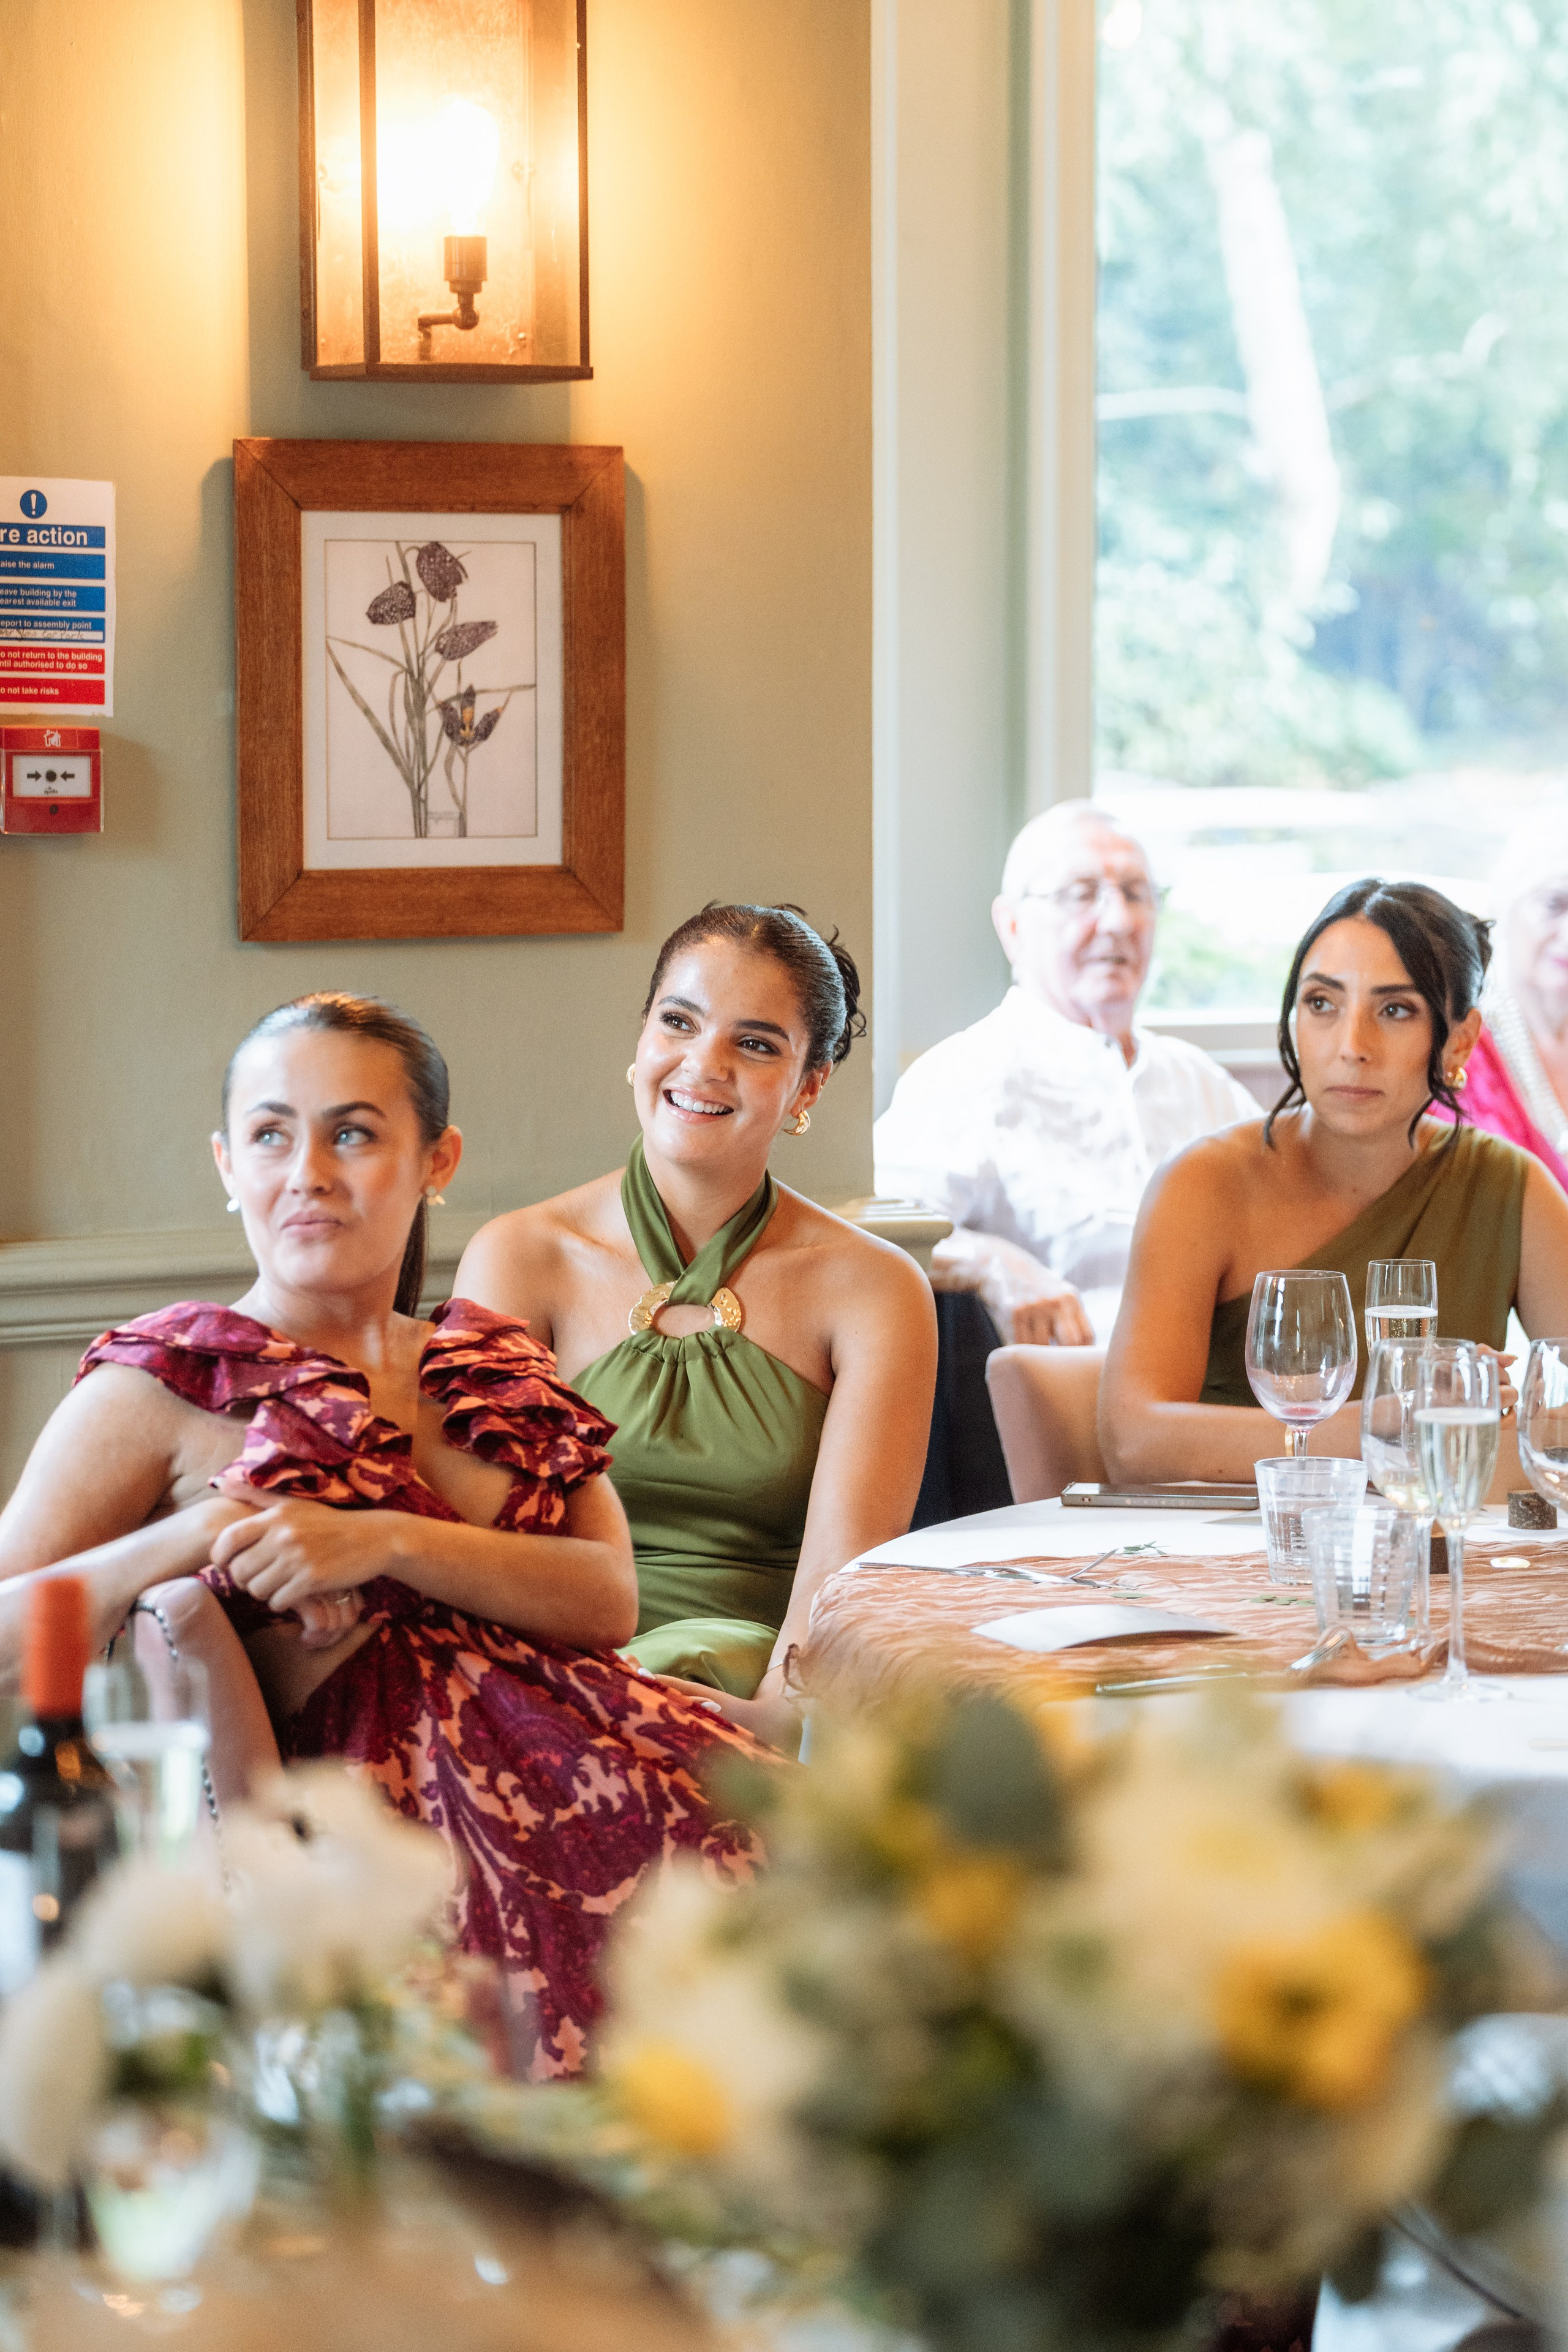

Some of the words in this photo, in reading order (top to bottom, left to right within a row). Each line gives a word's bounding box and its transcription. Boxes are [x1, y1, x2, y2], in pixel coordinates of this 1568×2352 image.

[0, 528, 20, 543] re
[27, 526, 88, 546] action
[1, 559, 17, 568] aise
[18, 560, 31, 569] the
[33, 560, 55, 570] alarm
[20, 588, 51, 598] building
[53, 589, 62, 599] by
[64, 589, 77, 598] the
[34, 620, 70, 630] assembly
[22, 651, 46, 660] return
[72, 652, 102, 662] building
[0, 659, 12, 668] ntil
[13, 660, 55, 669] authorised
[21, 687, 39, 695] take
[40, 687, 59, 696] risks
